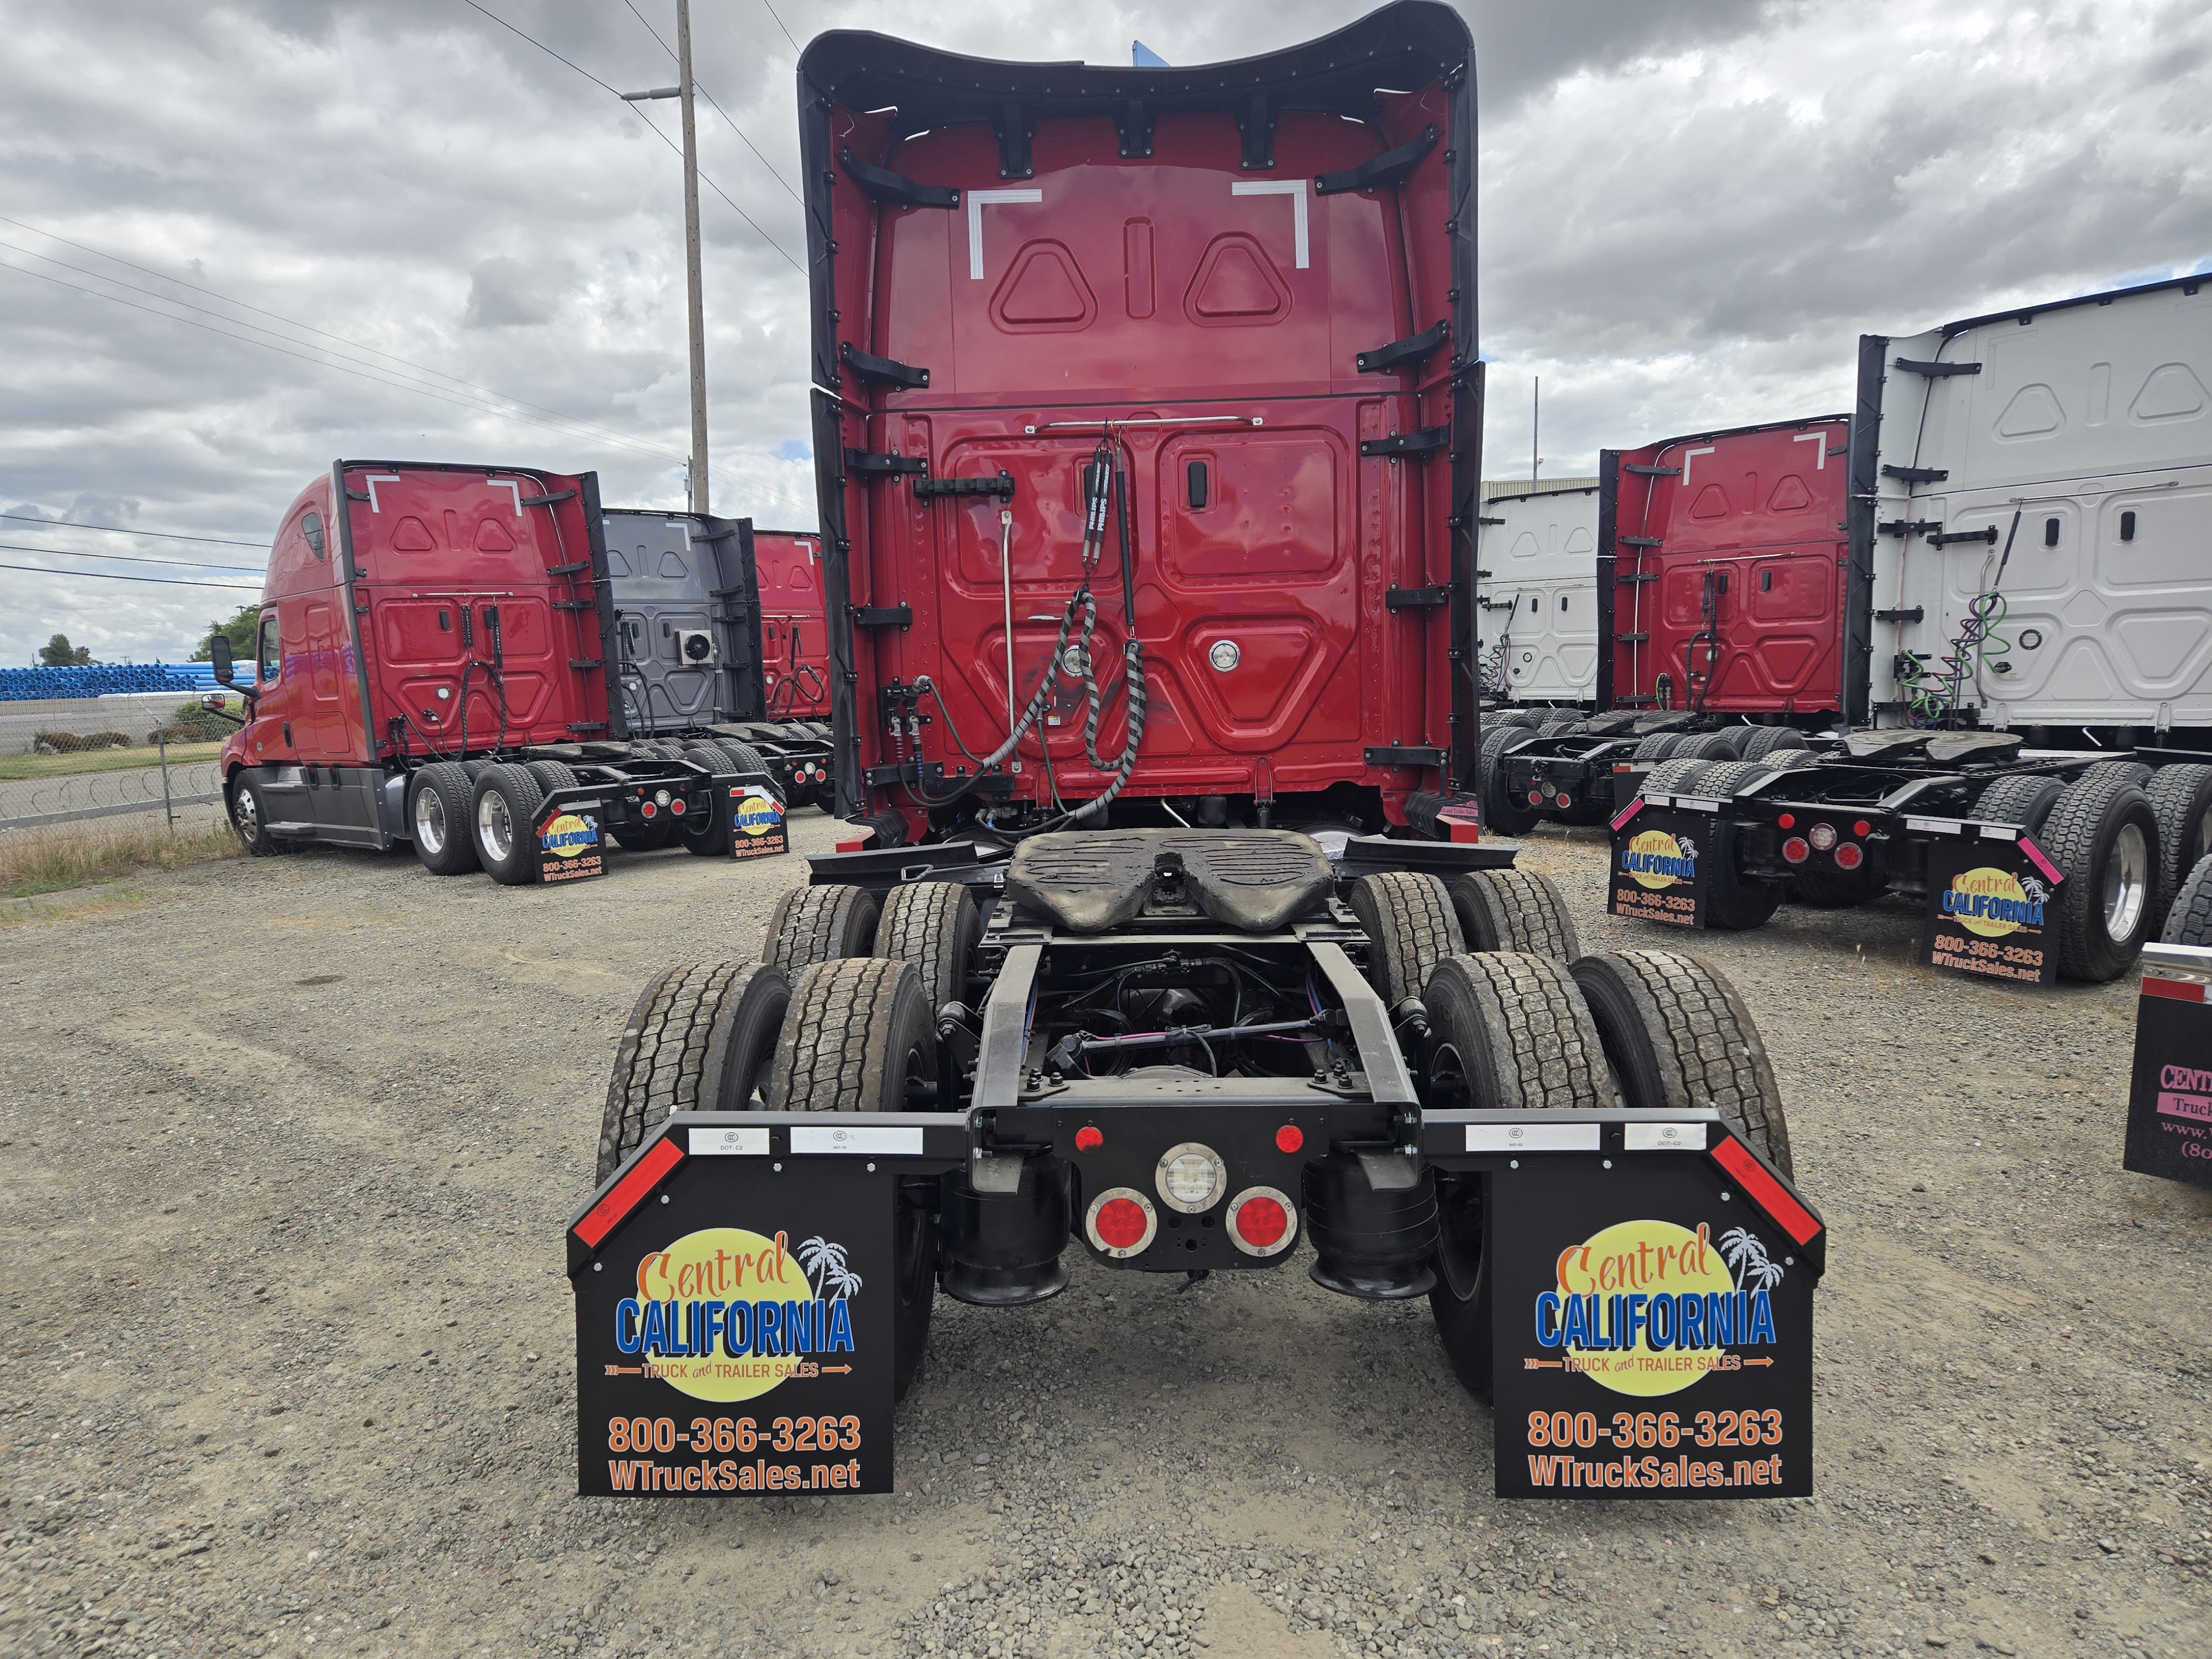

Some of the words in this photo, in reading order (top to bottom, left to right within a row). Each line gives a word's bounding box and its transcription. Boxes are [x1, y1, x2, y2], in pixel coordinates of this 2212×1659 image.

[1089, 497, 1098, 530] PHILLIPS
[1097, 498, 1107, 531] PHILLIPS
[546, 814, 582, 834] Central
[734, 811, 781, 827] CALIFORNIA
[542, 830, 598, 848] CALIFORNIA
[735, 835, 783, 848] 800-366-3263
[735, 844, 784, 857] WTruckSales.net
[1629, 833, 1676, 854] Central
[543, 855, 601, 872] 800-366-3263
[544, 866, 602, 881] WTruckSales.net
[1621, 850, 1695, 878] CALIFORNIA
[1952, 872, 2018, 894] Central
[1616, 902, 1694, 925] WTruckSales.net
[1617, 889, 1695, 911] 800-366-3263
[1943, 890, 2044, 925] CALIFORNIA
[1953, 915, 1973, 924] TRUCK
[1983, 920, 2007, 930] TRAILER
[2008, 925, 2028, 933] SALES
[1934, 935, 2043, 966] 800-366-3263
[1932, 951, 2041, 982] WTruckSales.net
[2160, 1065, 2212, 1092] CENT
[637, 1230, 790, 1305] Central
[1557, 1222, 1712, 1298] Central
[615, 1297, 855, 1356] CALIFORNIA
[1535, 1290, 1777, 1350] CALIFORNIA
[642, 1363, 688, 1379] TRUCK
[692, 1360, 712, 1379] and
[714, 1363, 770, 1379] TRAILER
[774, 1362, 819, 1378] SALES
[1562, 1357, 1610, 1373] TRUCK
[1615, 1353, 1634, 1373] and
[1637, 1357, 1693, 1372] TRAILER
[1697, 1355, 1741, 1371] SALES
[608, 1416, 861, 1453] 800-366-3263
[1527, 1409, 1783, 1448] 800-366-3263
[608, 1459, 860, 1491] WTruckSales.net
[1528, 1454, 1783, 1488] WTruckSales.net
